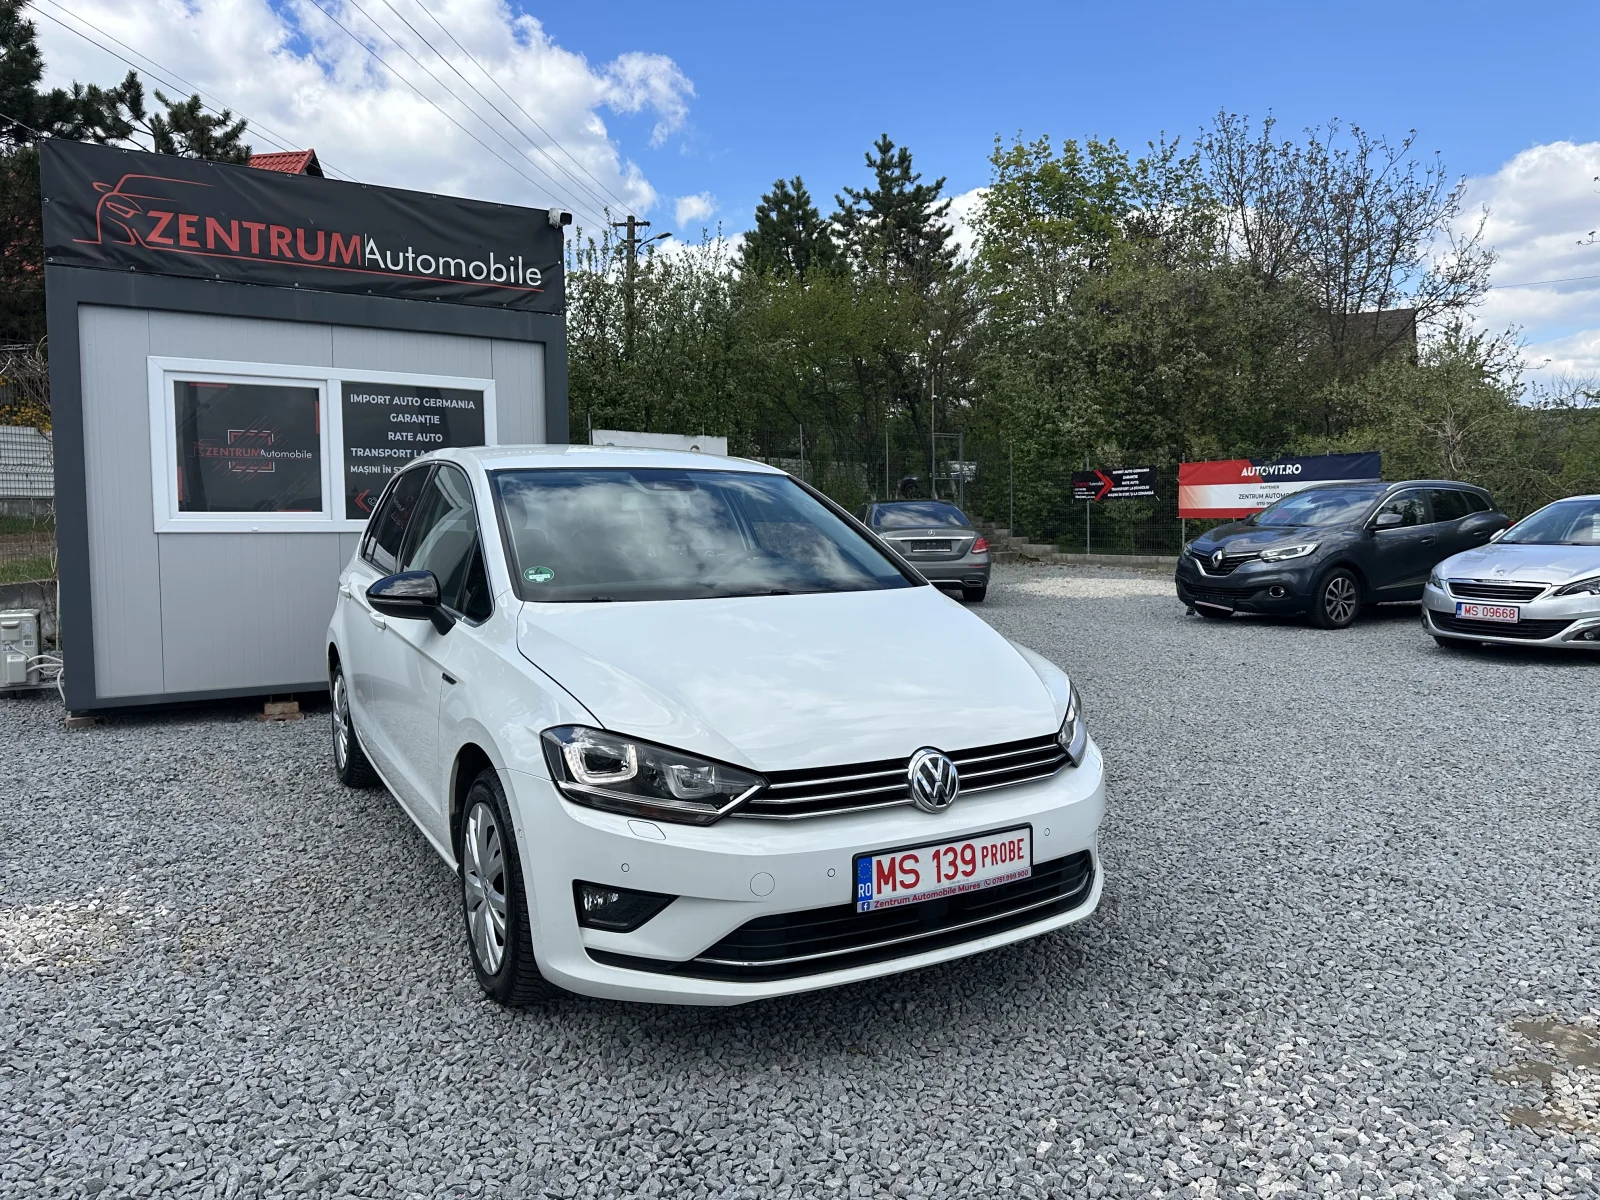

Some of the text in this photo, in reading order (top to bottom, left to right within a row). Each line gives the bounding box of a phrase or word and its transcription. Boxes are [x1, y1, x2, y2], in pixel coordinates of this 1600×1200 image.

[146, 210, 542, 287] ZENTRUM Automobile
[350, 393, 475, 409] IMPORT AUTO GERMANIA
[390, 413, 440, 426] GARANȚIE
[388, 431, 443, 442] RATE AUTO
[205, 447, 312, 459] ZENTRUM Automobile
[351, 447, 412, 458] TRANSPORT
[350, 465, 381, 475] MAȘINI
[382, 464, 392, 474] ÎN
[1240, 463, 1302, 477] AUTOVIT.RO
[1464, 605, 1479, 616] MS
[1482, 606, 1516, 619] 09668
[858, 838, 1025, 898] RO MS 139 PROBE
[874, 895, 911, 909] Zentrum
[911, 887, 957, 903] Automobile
[957, 883, 981, 893] Mures
